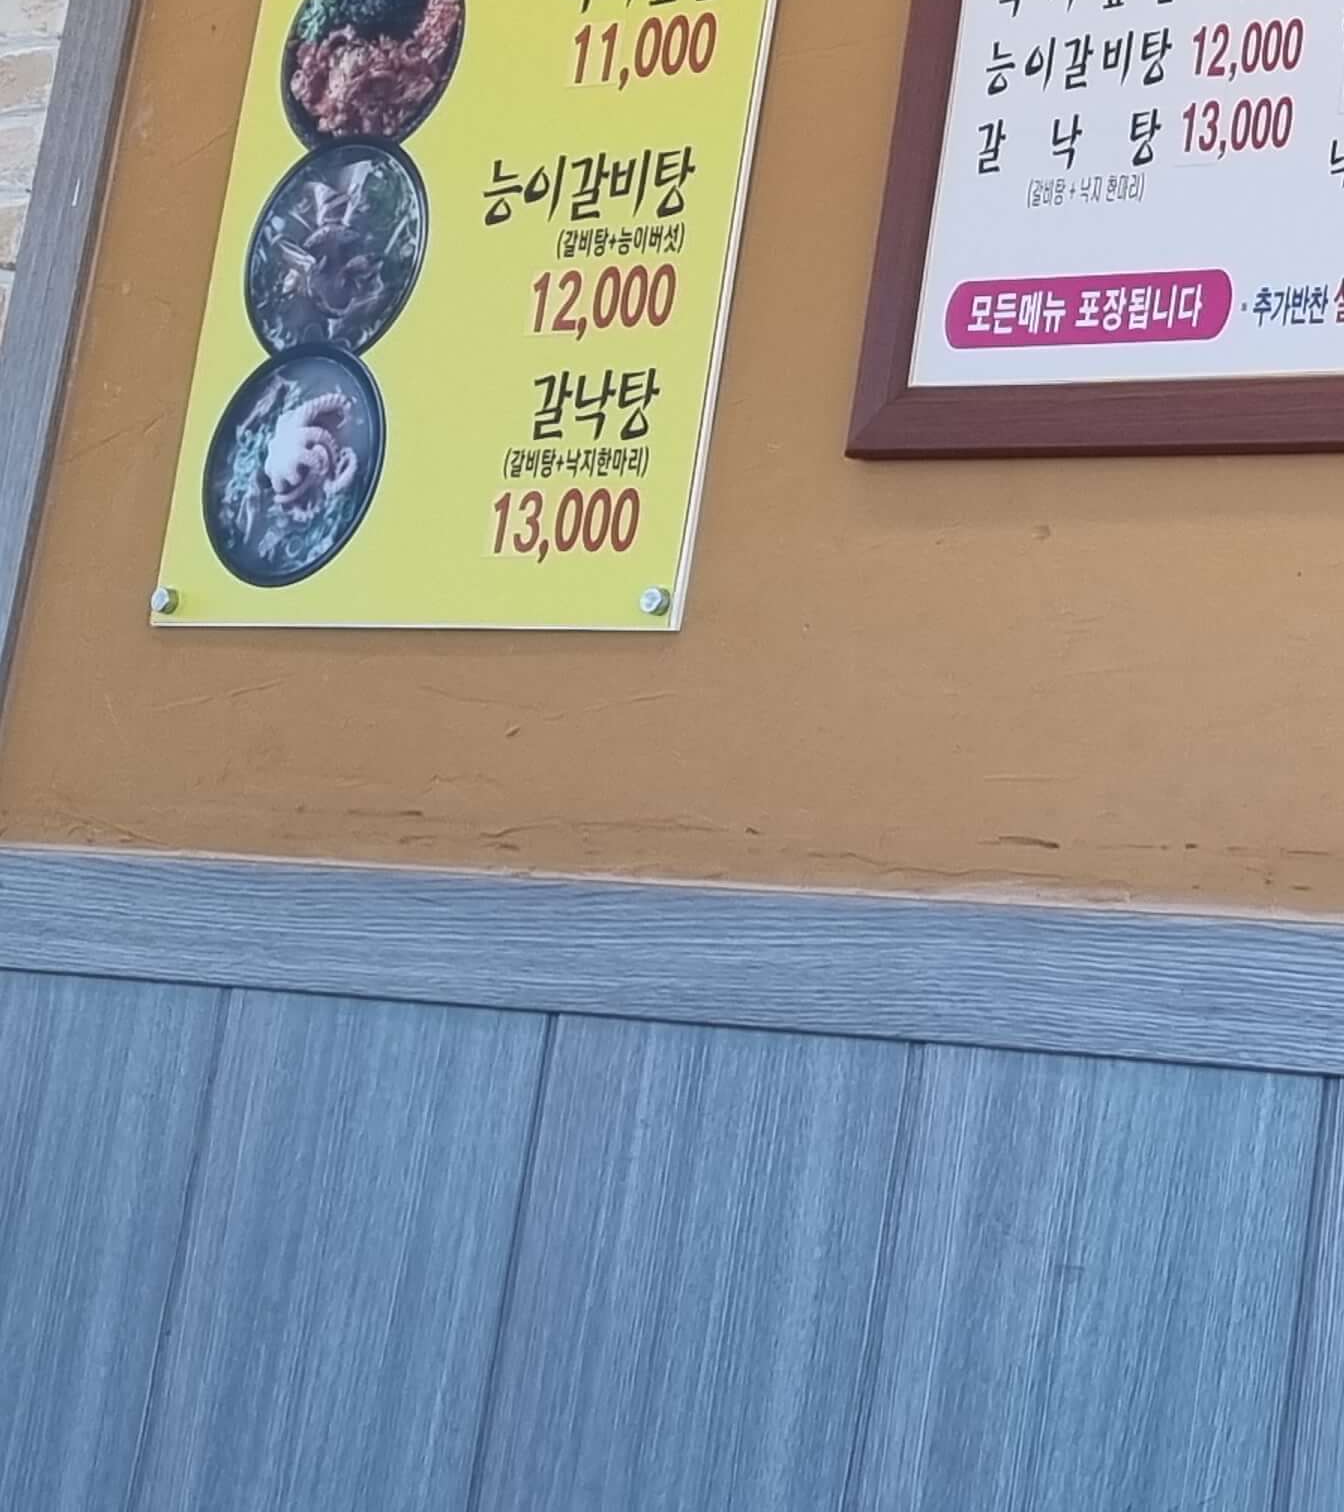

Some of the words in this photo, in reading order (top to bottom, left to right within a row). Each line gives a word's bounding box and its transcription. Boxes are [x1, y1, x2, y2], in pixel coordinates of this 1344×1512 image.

[574, 12, 716, 90] 11,000
[987, 28, 1173, 96] 능이갈비탕
[1193, 17, 1303, 82] 12,000
[1182, 96, 1293, 160] 13,000
[483, 146, 695, 226] 능이갈비탕
[557, 223, 684, 259] (갈비탕+능이버섯)
[531, 263, 677, 341] 12,000
[966, 293, 1066, 335] 모든메뉴
[1074, 283, 1203, 332] 포장됩니다
[1251, 285, 1328, 328] 추가반찬
[533, 368, 660, 442] 갈낙탕
[503, 446, 649, 479] (갈비탕+낙지한마리)
[492, 488, 640, 564] 13,000
